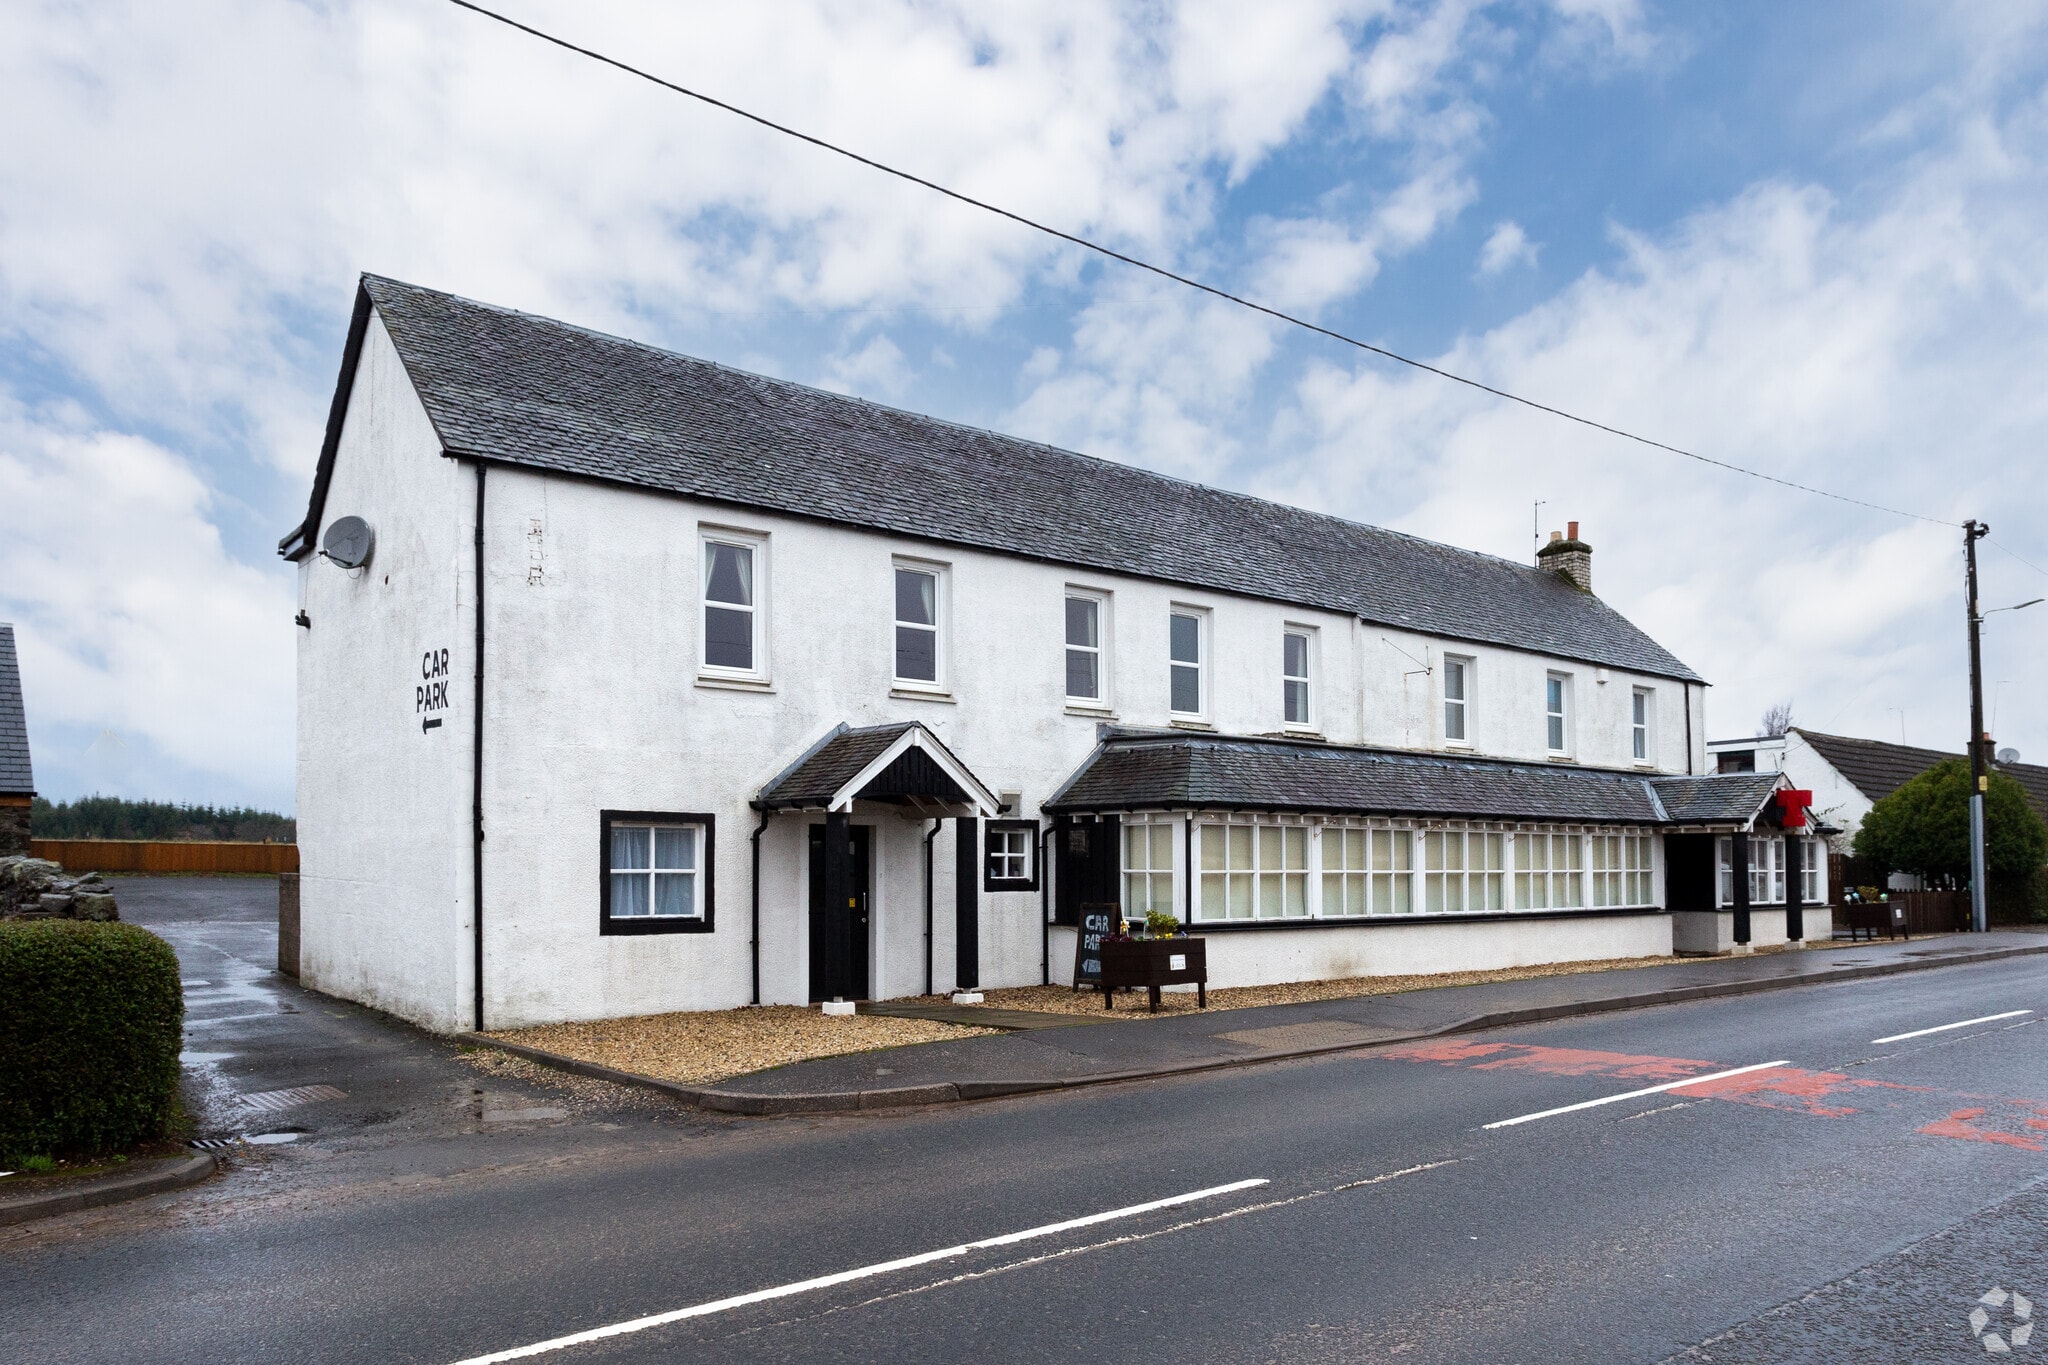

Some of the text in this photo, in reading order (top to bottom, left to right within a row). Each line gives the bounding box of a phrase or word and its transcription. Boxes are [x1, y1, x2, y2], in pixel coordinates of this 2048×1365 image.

[422, 648, 449, 680] CAR
[416, 680, 449, 713] PARK
[1776, 789, 1812, 827] T
[1085, 914, 1109, 931] CAR
[1084, 933, 1104, 950] PAR
